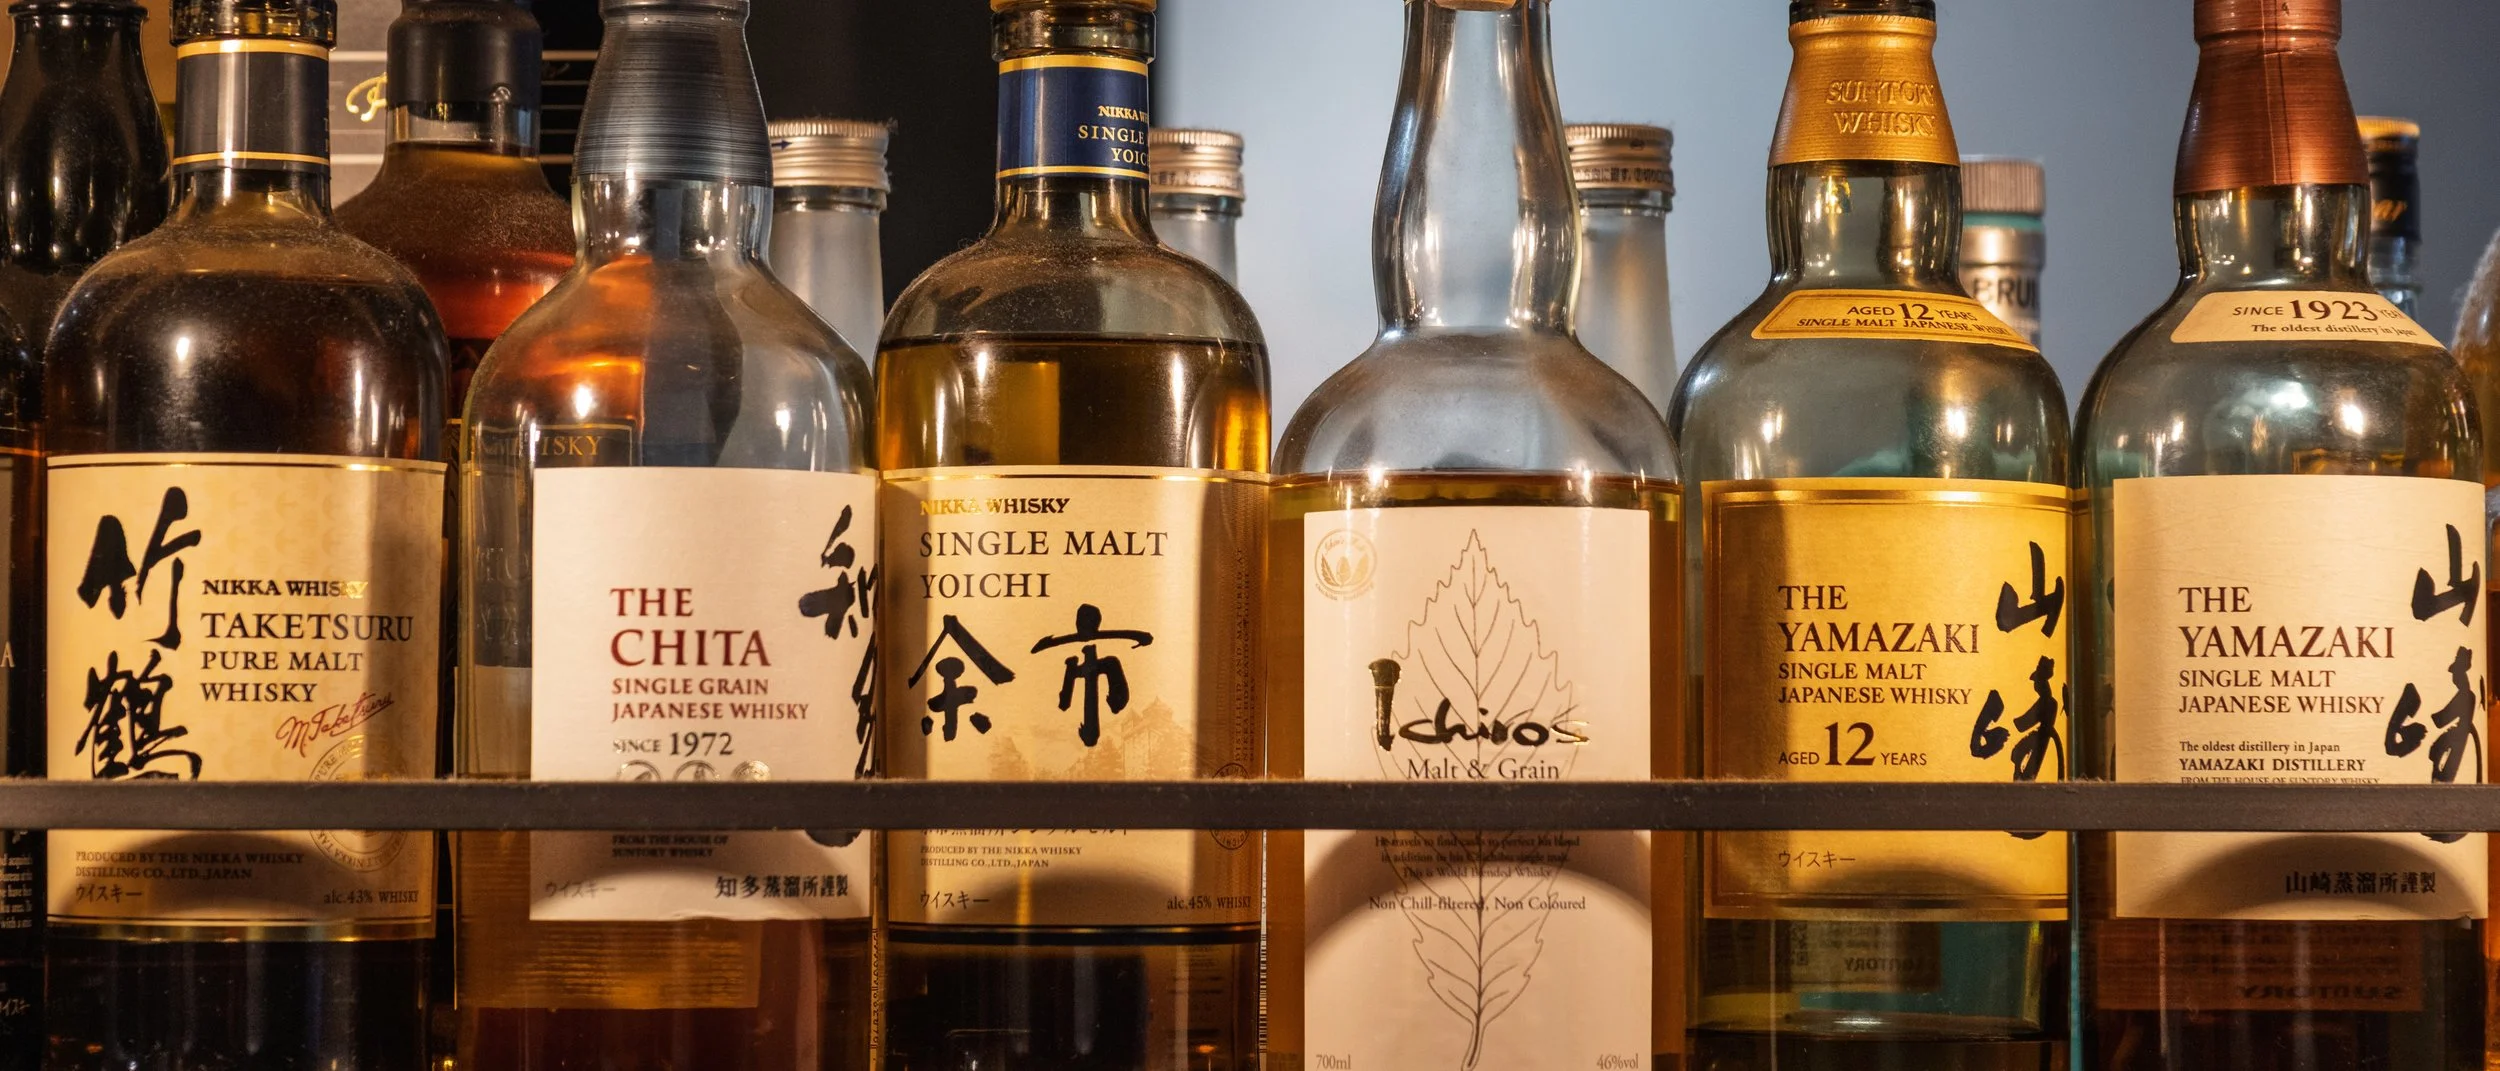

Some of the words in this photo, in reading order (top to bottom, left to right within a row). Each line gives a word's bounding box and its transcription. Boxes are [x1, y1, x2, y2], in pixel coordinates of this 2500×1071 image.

[1098, 105, 1139, 120] NIKKA
[1078, 125, 1145, 144] SINGLE
[1111, 147, 1149, 167] YOIC
[1847, 306, 1895, 316] AGED
[1898, 303, 1934, 320] 12
[1935, 309, 1977, 322] YEARS
[2233, 306, 2284, 316] SINCE
[2289, 300, 2379, 321] 1923
[1797, 318, 1851, 327] SINGLE
[1856, 318, 1897, 327] MALT
[1903, 320, 1973, 332] JAPANESE
[2251, 324, 2277, 332] The
[2281, 324, 2321, 333] oldest
[2325, 324, 2378, 336] distillery
[920, 498, 981, 515] NIKKA
[985, 498, 1070, 514] WHISKY
[920, 530, 1049, 558] SINGLE
[1063, 530, 1168, 556] MALT
[202, 579, 281, 596] NIKKA
[286, 580, 368, 599] WHISKY
[920, 573, 1051, 599] YOICHI
[609, 588, 694, 617] THE
[1778, 585, 1848, 610] THE
[2178, 587, 2252, 613] THE
[200, 613, 414, 641] TAKETSURU
[611, 629, 772, 667] CHITA
[1778, 622, 1980, 654] YAMAZAKI
[2178, 625, 2395, 658] YAMAZAKI
[201, 650, 278, 670] PURE
[287, 651, 363, 672] MALT
[908, 603, 1154, 748] 余市
[1778, 663, 1858, 680] SINGLE
[1866, 663, 1927, 680] MALT
[2179, 669, 2262, 688] SINGLE
[2271, 670, 2336, 688] MALT
[200, 682, 318, 702] WHISKY
[612, 678, 693, 695] SINGLE
[699, 678, 769, 695] GRAIN
[1778, 686, 1885, 704] JAPANESE
[1890, 687, 1972, 705] WHISKY
[611, 702, 723, 723] JAPANESE
[729, 703, 809, 719] WHISKY
[2179, 695, 2291, 713] JAPANESE
[2297, 696, 2385, 714] WHISKY
[613, 739, 662, 753] SINCE
[669, 731, 734, 757] 1972
[1778, 752, 1820, 765] AGED
[1824, 722, 1876, 766] 12
[1881, 752, 1927, 766] YEARS
[2179, 741, 2199, 752] The
[2202, 740, 2235, 752] oldest
[2239, 741, 2290, 754] distillery
[2294, 742, 2305, 752] in
[2309, 741, 2340, 755] Japan
[1407, 757, 1458, 779] Malt
[1467, 758, 1485, 779] &
[1498, 757, 1560, 779] Grain
[2179, 758, 2265, 771] YAMAZAKI
[2272, 759, 2366, 772] DISTILLERY
[76, 851, 136, 863] PRODUCED
[139, 852, 155, 863] BY
[158, 852, 189, 864] THE
[191, 852, 242, 864] NIKKA
[245, 852, 304, 865] WHISKY
[921, 845, 965, 855] PRODUCED
[967, 846, 978, 855] BY
[982, 846, 1000, 855] THE
[1004, 846, 1038, 855] NIKKA
[1041, 847, 1082, 856] WHISKY
[1778, 849, 1856, 869] ウイスキー
[921, 858, 969, 867] DISTILLING
[76, 867, 139, 879] DISTILLING
[2285, 871, 2436, 894] 山崎蒸溜所謹製
[76, 883, 142, 903] ウイスキー
[545, 880, 616, 898] ウイスキー
[715, 874, 849, 899] 知多蒸溜所謹製
[378, 890, 419, 904] WHISKY
[920, 890, 990, 910] ウイスキー
[1217, 896, 1252, 909] WHISKY
[1369, 896, 1396, 910] Non
[1494, 896, 1523, 910] Non
[1528, 895, 1586, 910] Coloured
[1316, 1054, 1351, 1070] 700ml
[1596, 1053, 1639, 1070] 46%vol
